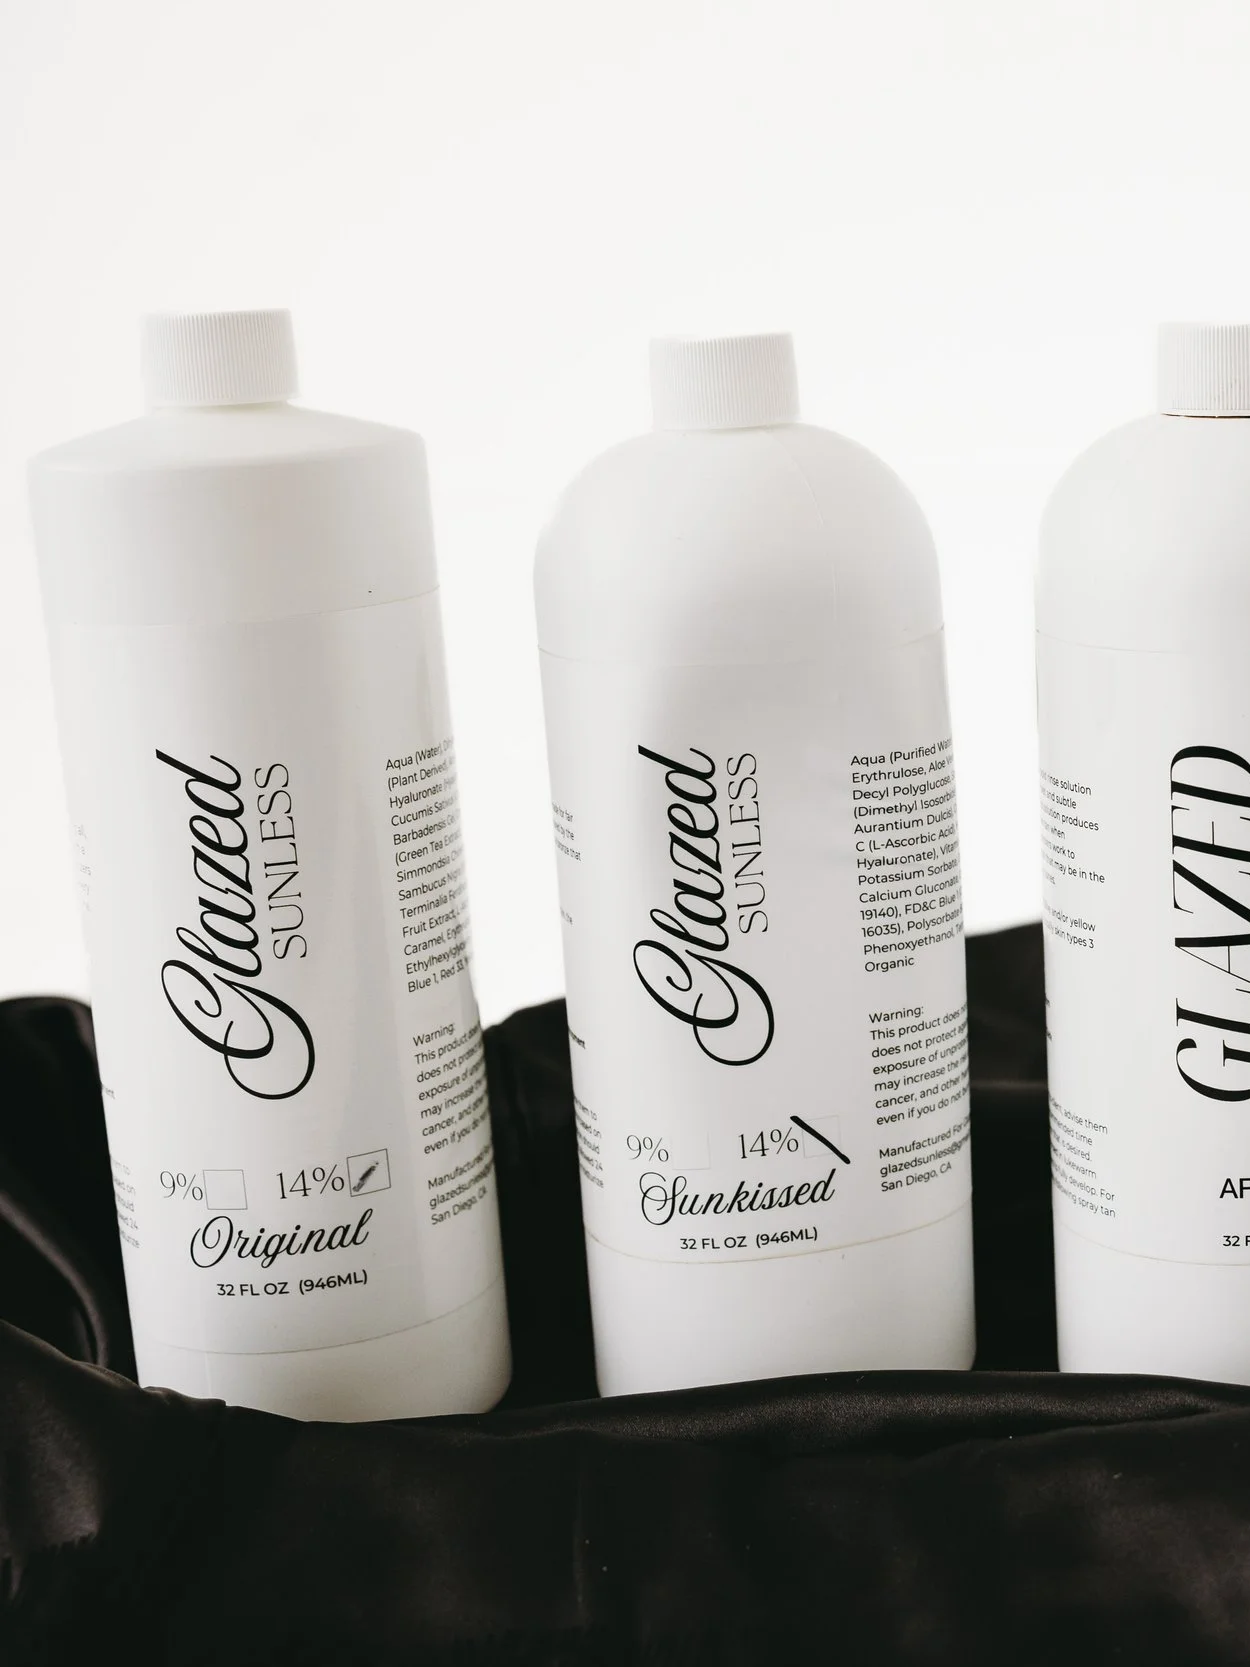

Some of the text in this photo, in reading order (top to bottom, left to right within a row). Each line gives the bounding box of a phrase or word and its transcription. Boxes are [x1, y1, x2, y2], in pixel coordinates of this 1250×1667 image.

[385, 755, 413, 771] Aqua
[850, 743, 936, 767] Aqua (Purified
[387, 772, 419, 792] (Plant
[852, 760, 946, 785] Erythrulose, Aloe
[852, 787, 889, 801] Decyl
[1060, 780, 1092, 795] solution
[853, 800, 918, 820] (Dimethyl
[1056, 794, 1077, 809] subtle
[391, 805, 434, 826] Cucumis
[853, 817, 924, 834] Aurantium
[1061, 813, 1099, 831] produces
[726, 752, 769, 934] SUNLESS
[855, 831, 937, 853] C (L-Ascorbic
[254, 762, 308, 960] SUNLESS
[395, 846, 429, 866] (Green
[856, 847, 939, 870] Hyaluronate),
[858, 869, 925, 886] Potassium
[1089, 871, 1105, 883] the
[398, 876, 447, 901] Sambucus
[859, 889, 912, 903] Calcium
[399, 894, 448, 919] Terminalia
[632, 744, 775, 1067] Glazed
[860, 899, 937, 921] 19140), FD&C
[155, 748, 316, 1100] Glazed
[402, 921, 427, 938] Fruit
[861, 923, 904, 938] 16035),
[1070, 918, 1096, 932] yellow
[864, 955, 915, 972] Organic
[408, 977, 432, 993] Blue
[868, 1005, 924, 1024] Warning:
[870, 1010, 960, 1041] This product does
[871, 1028, 957, 1058] does not protect
[415, 1052, 436, 1065] This
[872, 1056, 926, 1075] exposure
[416, 1067, 442, 1083] does
[874, 1066, 946, 1092] may increase
[418, 1075, 461, 1101] exposure
[875, 1083, 939, 1109] cancer, and
[420, 1103, 443, 1120] may
[876, 1103, 936, 1126] even you
[1084, 1118, 1108, 1135] them
[423, 1138, 449, 1155] even
[626, 1126, 799, 1162] 9% 14%
[879, 1127, 952, 1160] Manufactured
[159, 1170, 204, 1201] 9%
[276, 1164, 345, 1200] 14%
[880, 1178, 903, 1192] San
[639, 1168, 837, 1226] Sunkissed
[431, 1209, 451, 1226] San
[1100, 1205, 1116, 1218] tan
[189, 1208, 374, 1269] Original
[679, 1226, 818, 1250] 32 FL OZ (946ML)
[1222, 1235, 1241, 1247] 32
[216, 1269, 368, 1297] 32 FL OZ (946ML)
